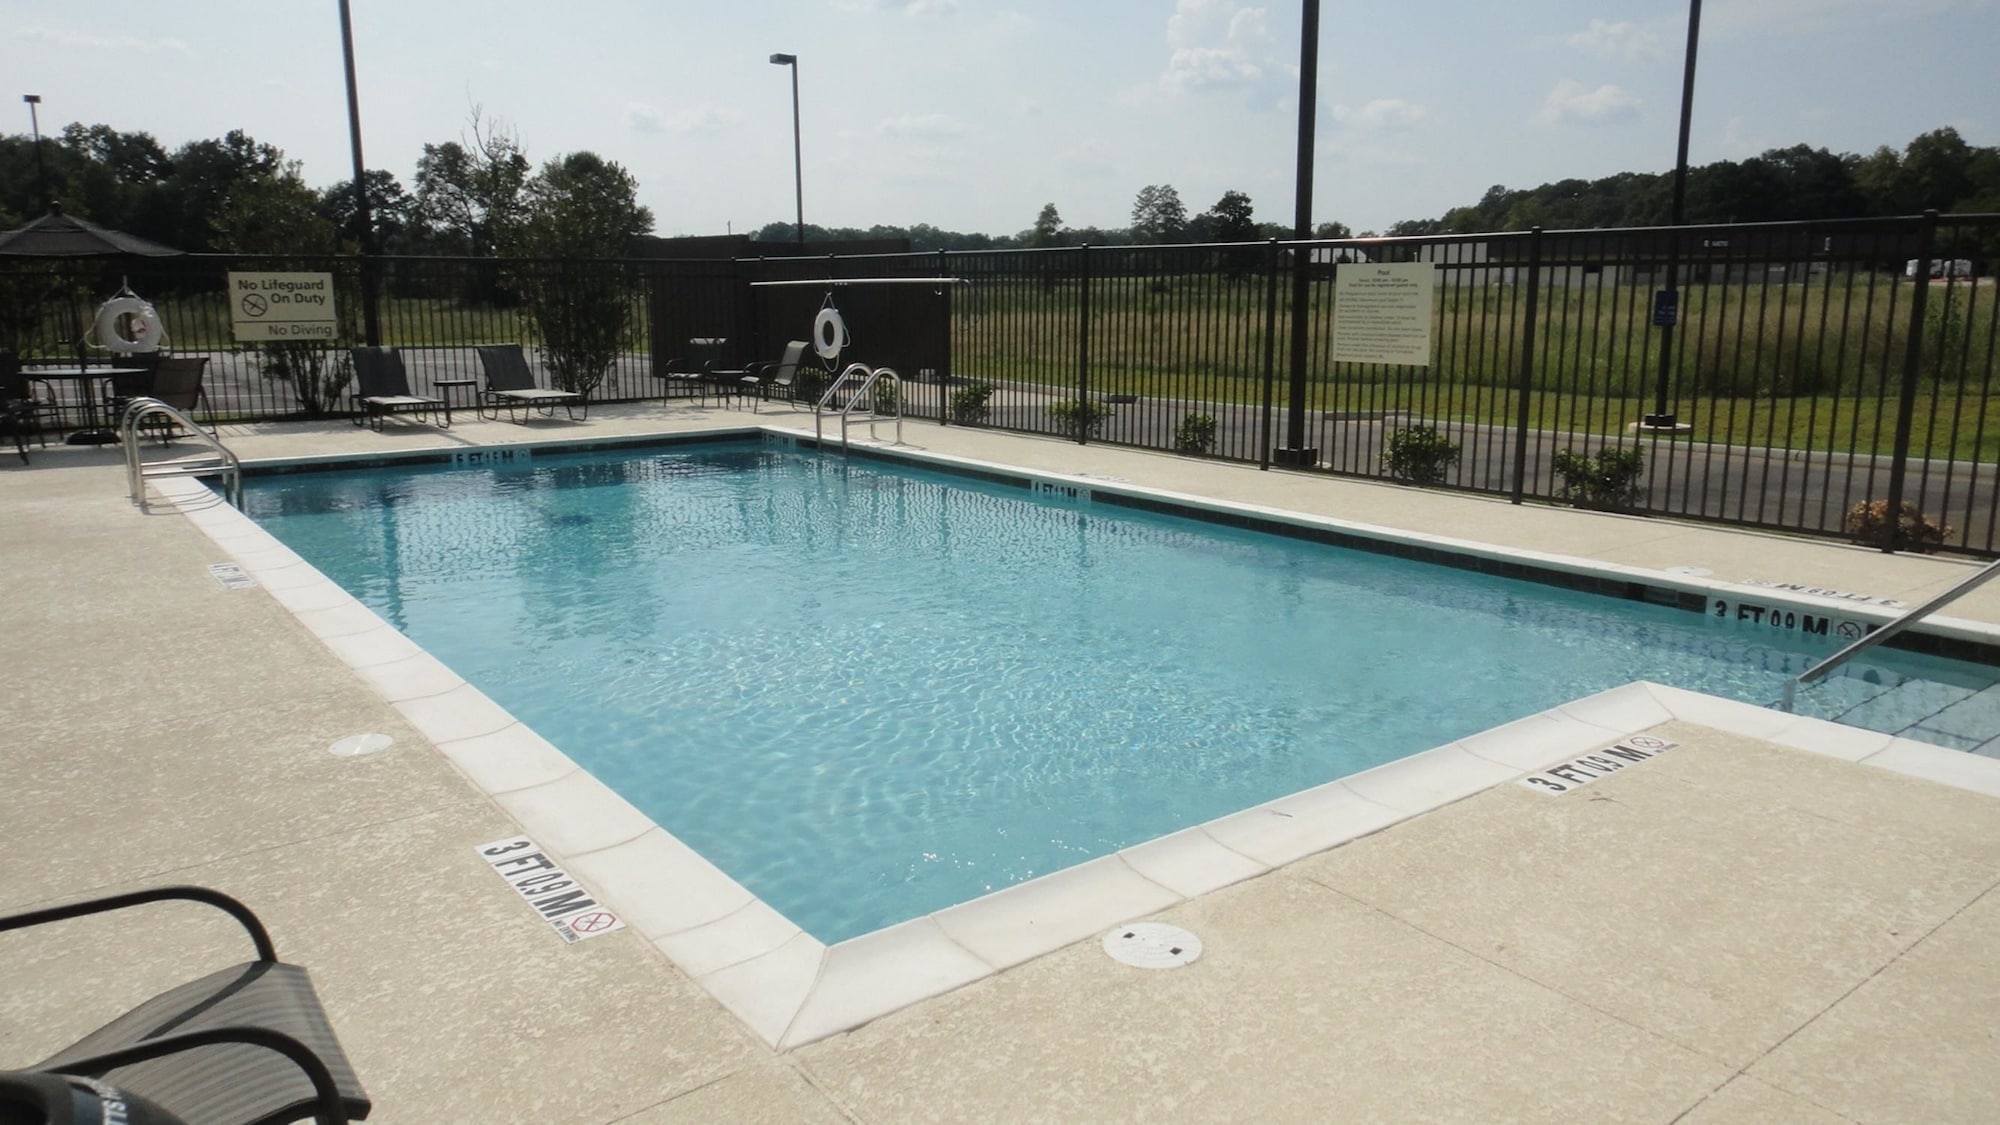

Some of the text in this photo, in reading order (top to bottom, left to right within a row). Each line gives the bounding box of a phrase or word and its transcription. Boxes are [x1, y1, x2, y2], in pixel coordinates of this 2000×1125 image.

[238, 279, 325, 293] No Lifeguard
[270, 293, 326, 305] On Duty
[268, 324, 333, 337] No Diving
[1715, 600, 1727, 618] 3
[1802, 615, 1829, 636] M
[1527, 777, 1567, 791] 3
[1602, 745, 1654, 762] M
[483, 841, 531, 856] 3
[533, 889, 597, 918] M
